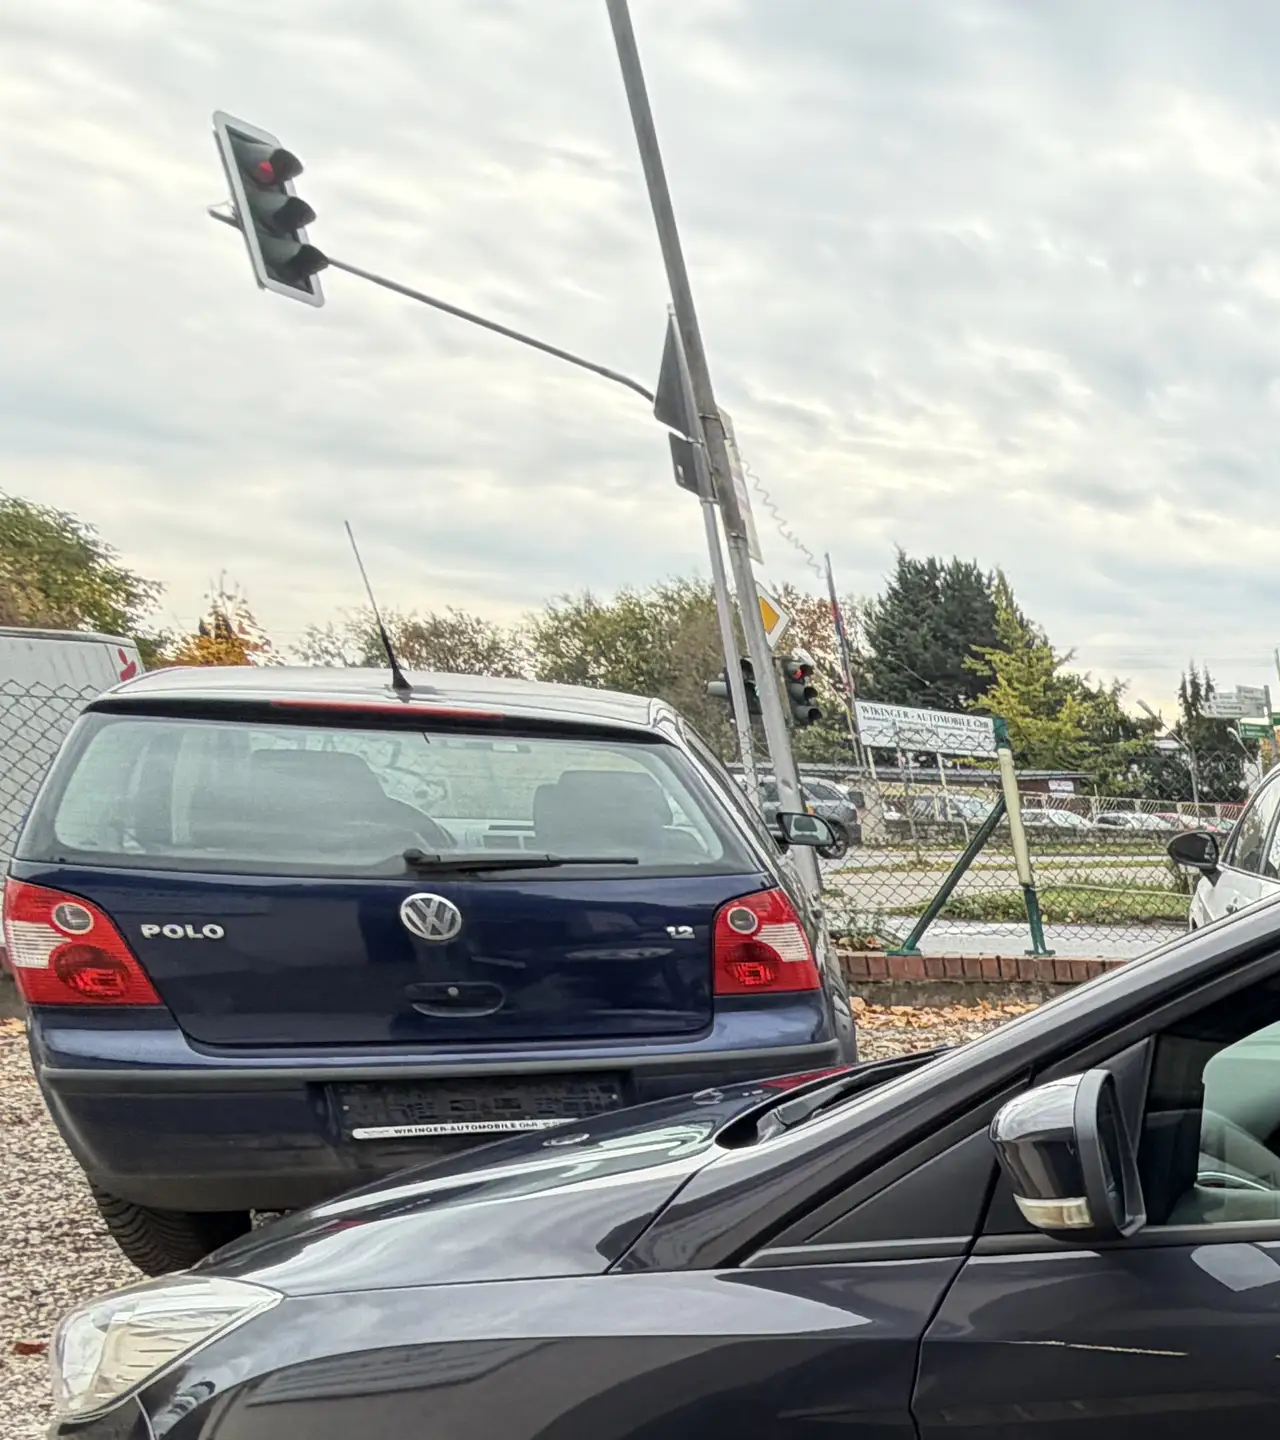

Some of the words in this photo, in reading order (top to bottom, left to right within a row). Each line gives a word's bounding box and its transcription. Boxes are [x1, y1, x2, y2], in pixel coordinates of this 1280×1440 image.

[860, 705, 909, 719] WIKINGER
[916, 712, 972, 728] AUTOMOBILE
[141, 924, 225, 939] POLO
